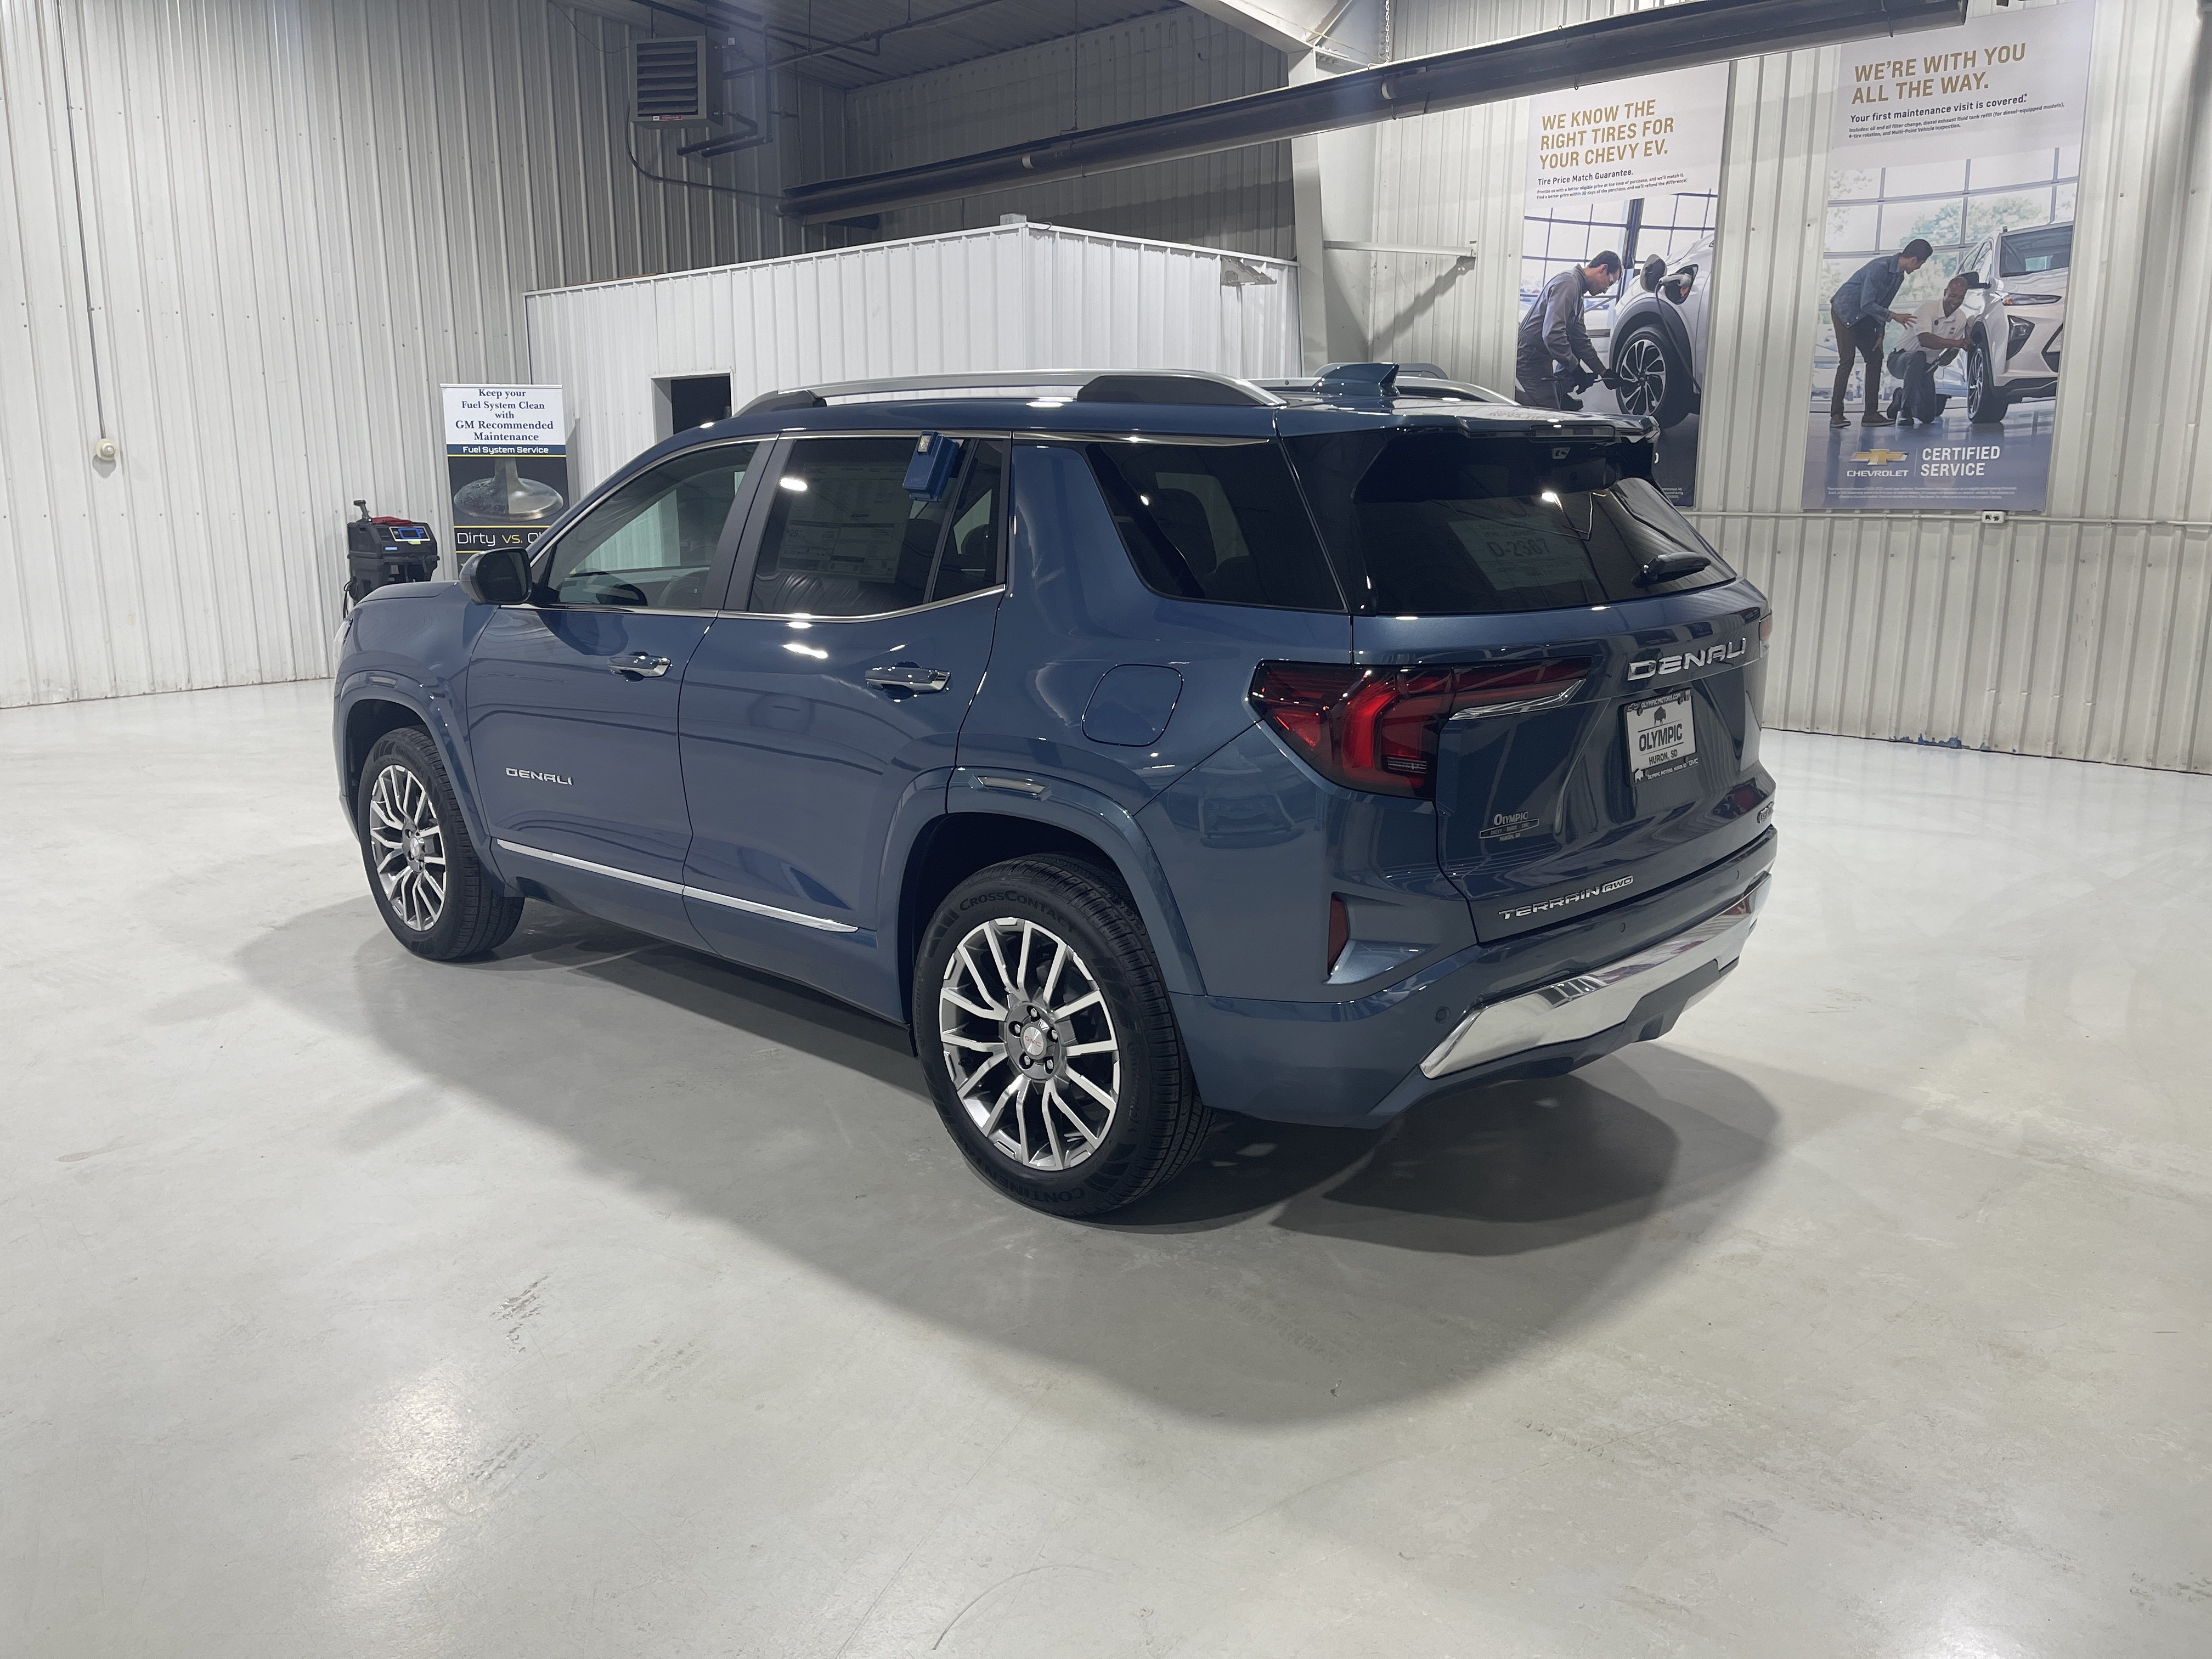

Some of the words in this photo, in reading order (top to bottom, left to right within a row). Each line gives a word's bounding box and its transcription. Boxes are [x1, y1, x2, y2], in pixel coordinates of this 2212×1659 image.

[1855, 59, 1916, 82] WE'RE
[1923, 50, 1977, 74] WITH
[1984, 43, 2027, 64] YOU
[1852, 84, 1889, 105] ALL
[1895, 80, 1933, 100] THE
[1940, 71, 1989, 94] WAY.
[1542, 114, 1566, 131] WE
[1571, 105, 1620, 128] KNOW
[1624, 99, 1656, 118] THE
[1872, 112, 1891, 121] first
[1894, 106, 1951, 119] maintenance
[1954, 102, 1973, 111] visit
[1976, 101, 1983, 109] is
[2003, 105, 2042, 115] diesel-equipped
[1541, 130, 1587, 150] RIGHT
[1592, 122, 1637, 144] TIRES
[1643, 117, 1674, 137] FOR
[1539, 151, 1579, 170] YOUR
[1585, 142, 1639, 165] CHEVY
[1644, 138, 1668, 157] EV.
[1572, 173, 1593, 182] Match
[1595, 170, 1633, 180] Guarantee.
[478, 388, 502, 399] Keep
[505, 391, 527, 399] your
[484, 401, 516, 411] System
[518, 401, 545, 409] Clean
[455, 420, 475, 429] GM
[478, 420, 554, 429] Recommended
[473, 432, 539, 441] Maintenance
[482, 446, 515, 455] System
[1921, 445, 2001, 461] CERTIFIED
[1920, 462, 1985, 477] SERVICE
[457, 532, 495, 546] Dirty
[501, 534, 523, 544] vs.
[1627, 637, 1747, 681] DENALI
[1639, 723, 1683, 752] OLYMPIC
[1649, 753, 1670, 765] HURON,
[1671, 749, 1678, 758] SD
[506, 768, 574, 786] DENALI
[1493, 811, 1528, 826] OLYMPIC
[1498, 887, 1600, 919] TERRAIN
[1603, 877, 1632, 891] AWD
[1025, 1035, 1042, 1048] GMC
